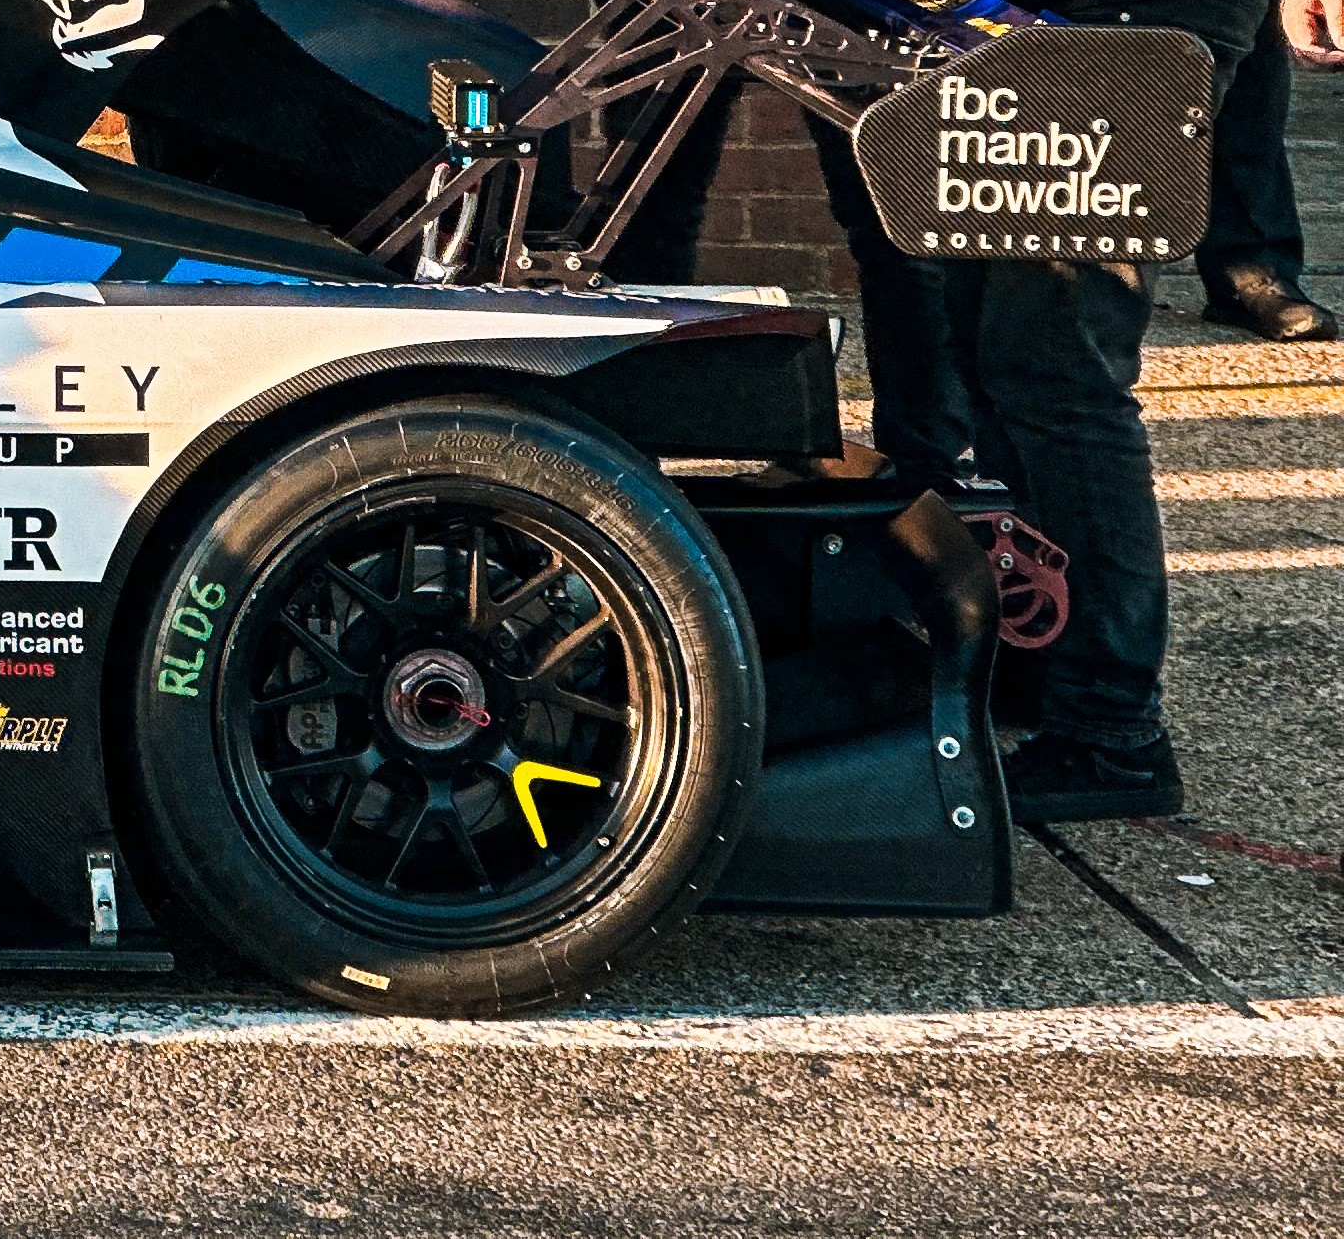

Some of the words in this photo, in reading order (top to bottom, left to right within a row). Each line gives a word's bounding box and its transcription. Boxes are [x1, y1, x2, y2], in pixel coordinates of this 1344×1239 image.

[938, 75, 1019, 122] fbc
[938, 121, 1113, 178] manby
[938, 167, 1150, 218] bowdler.
[924, 231, 1172, 255] SOLICITORS
